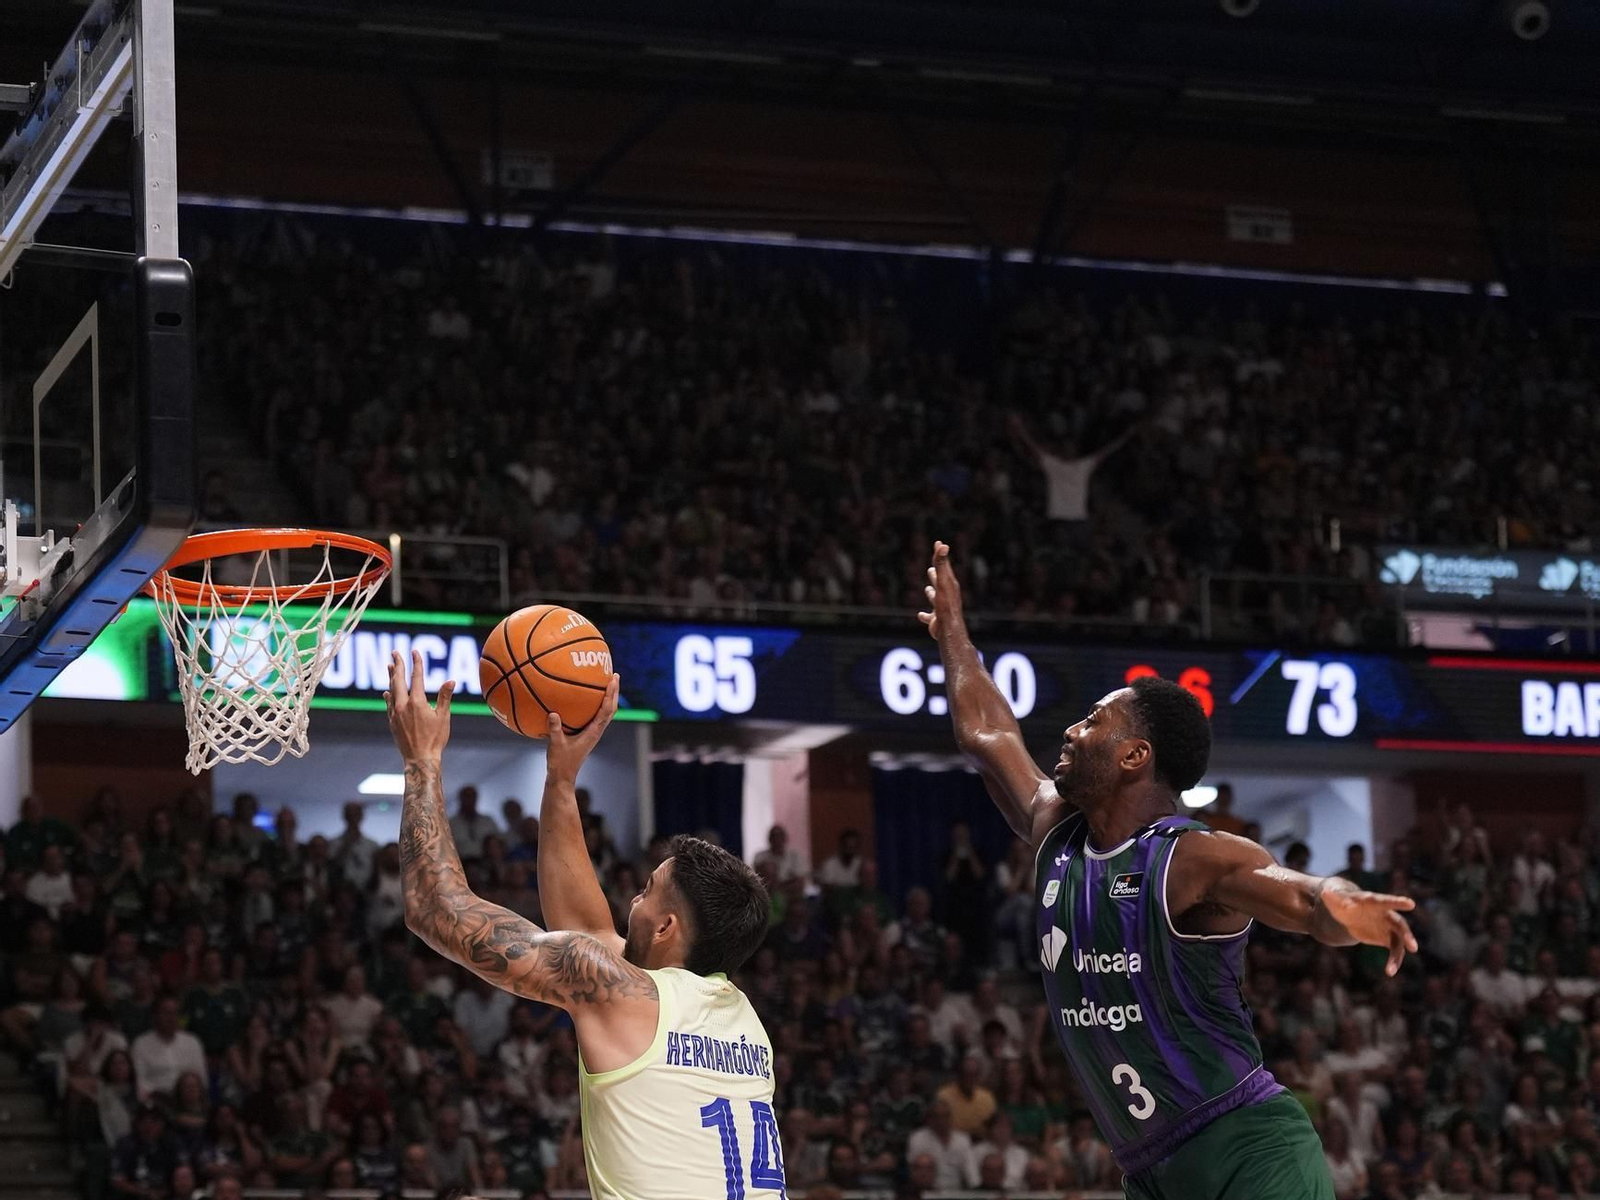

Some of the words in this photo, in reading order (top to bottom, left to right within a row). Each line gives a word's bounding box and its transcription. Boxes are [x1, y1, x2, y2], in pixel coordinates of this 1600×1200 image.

[674, 634, 756, 714] 65
[880, 647, 1036, 720] 6:0
[1281, 660, 1358, 737] 73
[1073, 948, 1141, 979] Unicaja
[1111, 1063, 1156, 1120] 3
